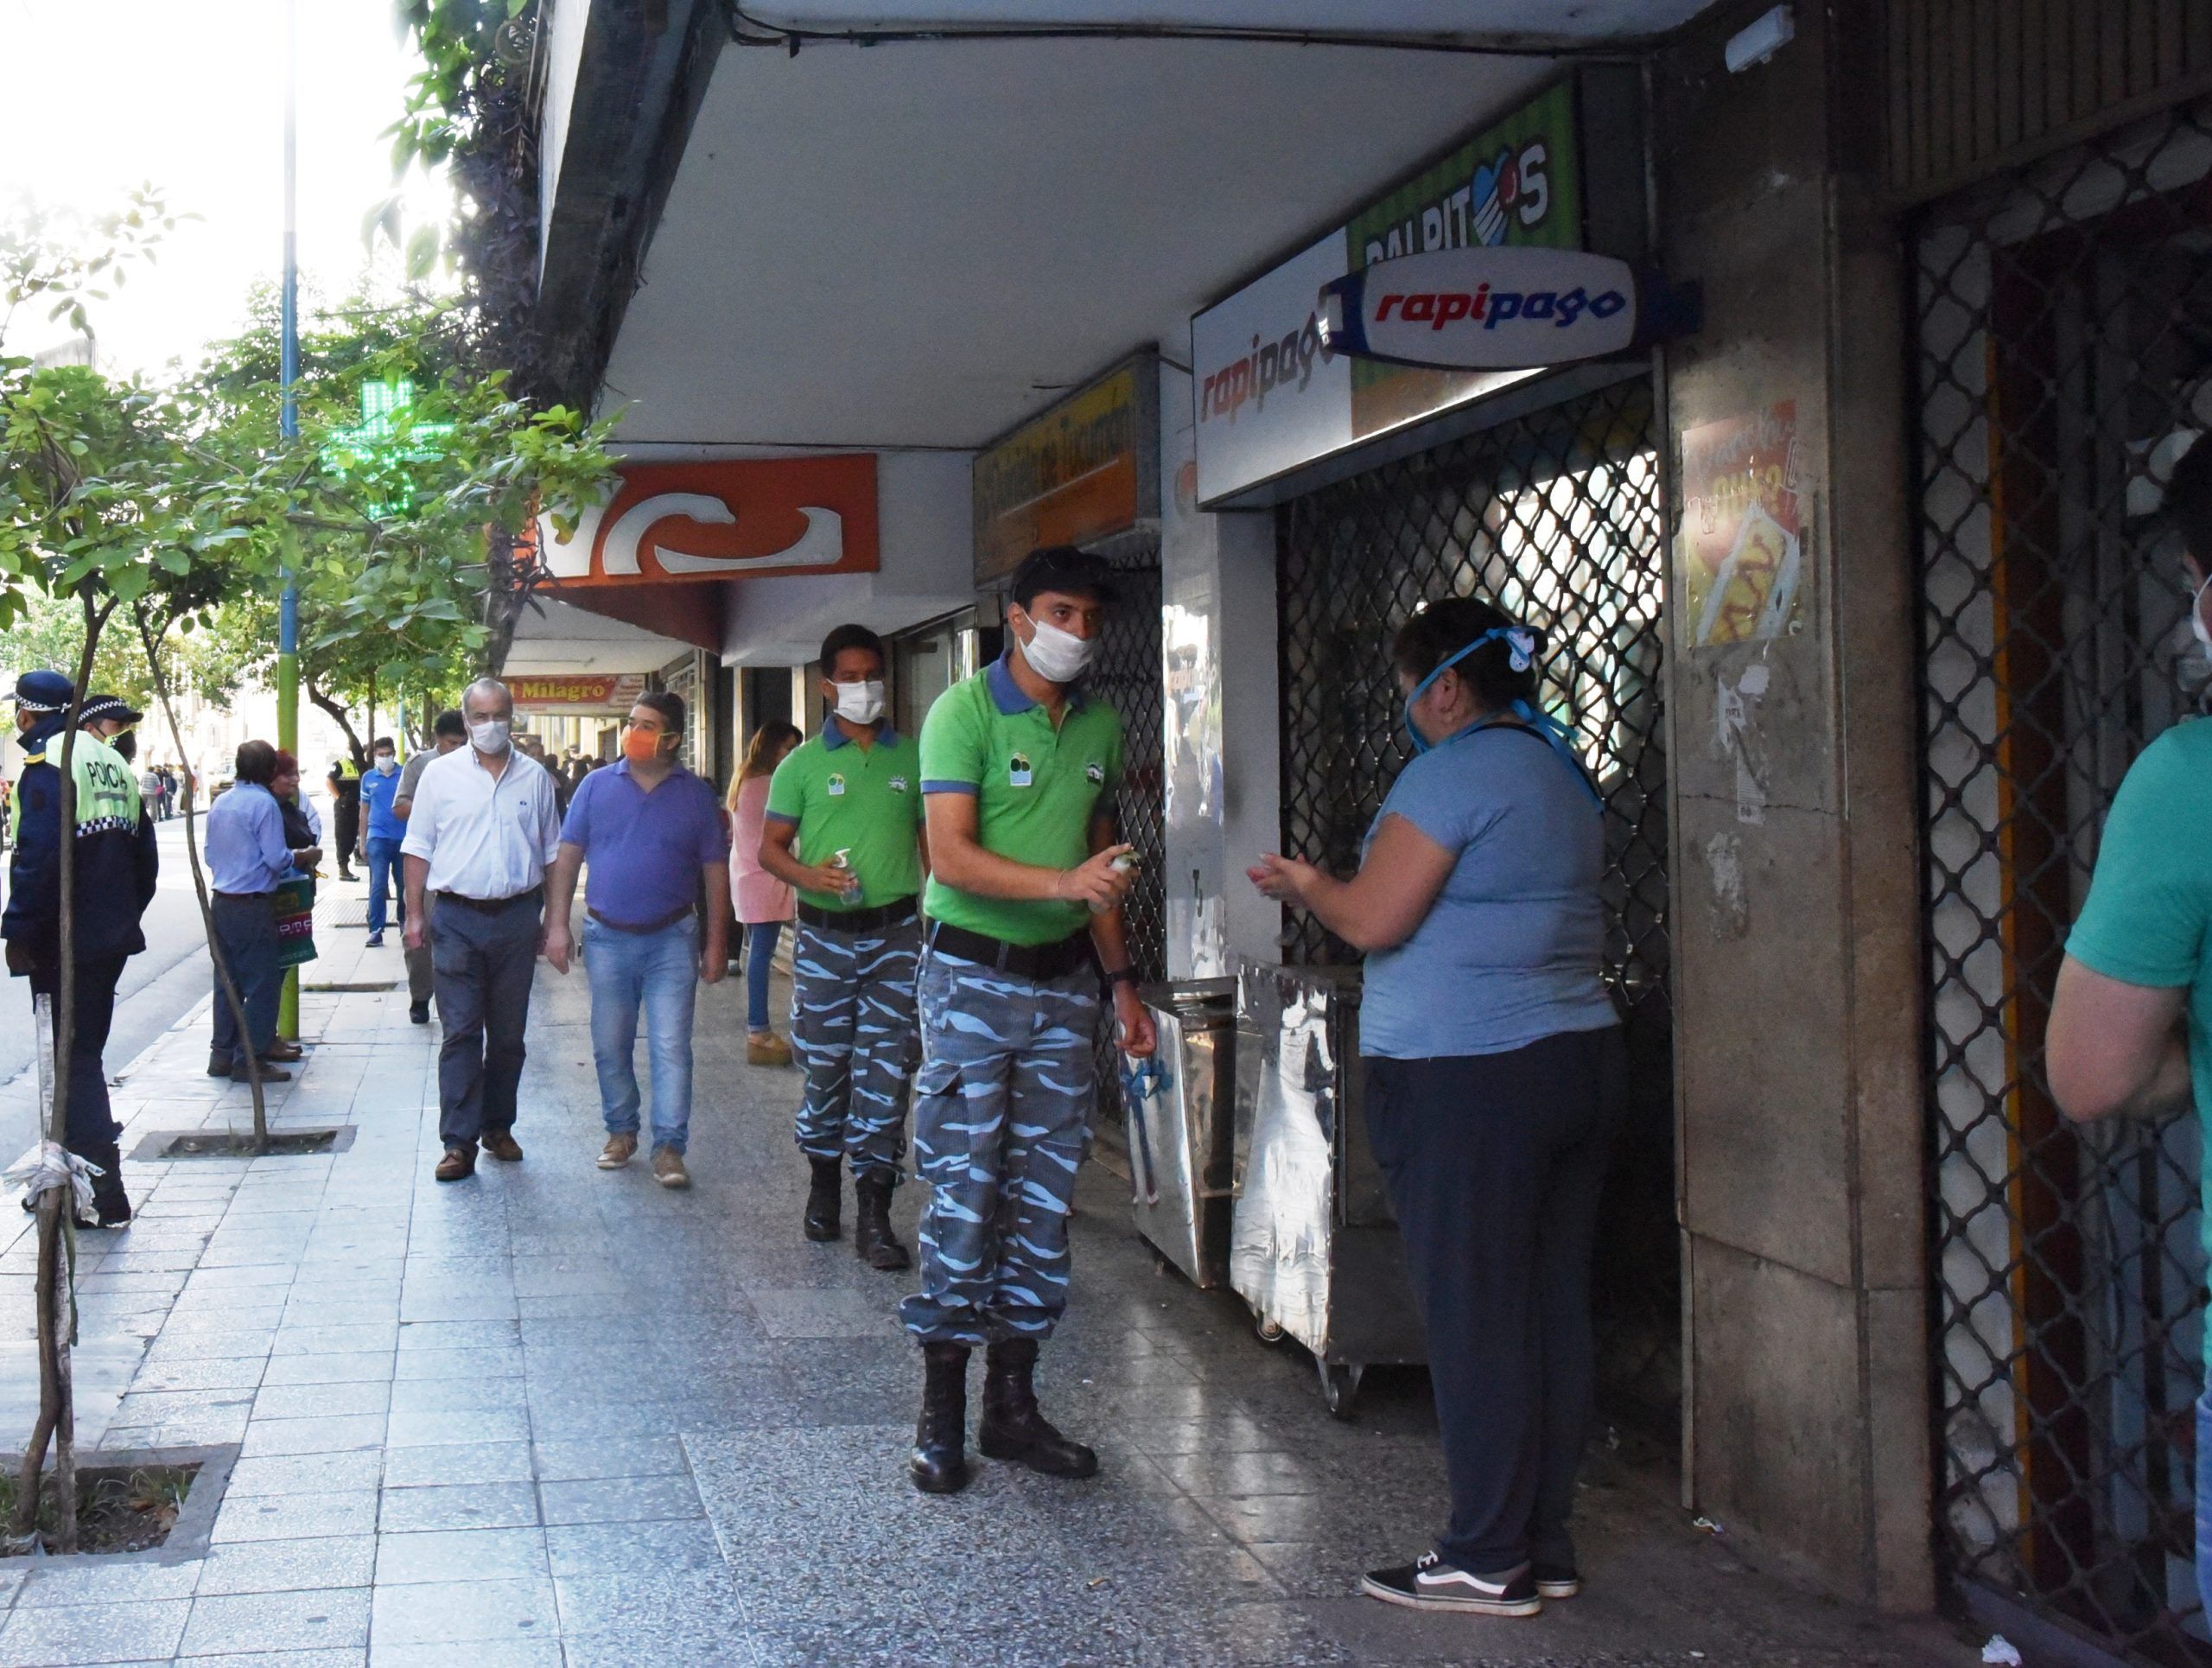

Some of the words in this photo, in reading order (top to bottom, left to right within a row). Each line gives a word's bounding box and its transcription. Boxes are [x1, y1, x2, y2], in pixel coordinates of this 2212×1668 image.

[1375, 283, 1627, 331] rapipago
[522, 681, 606, 702] Milagro
[86, 761, 128, 791] POICIA
